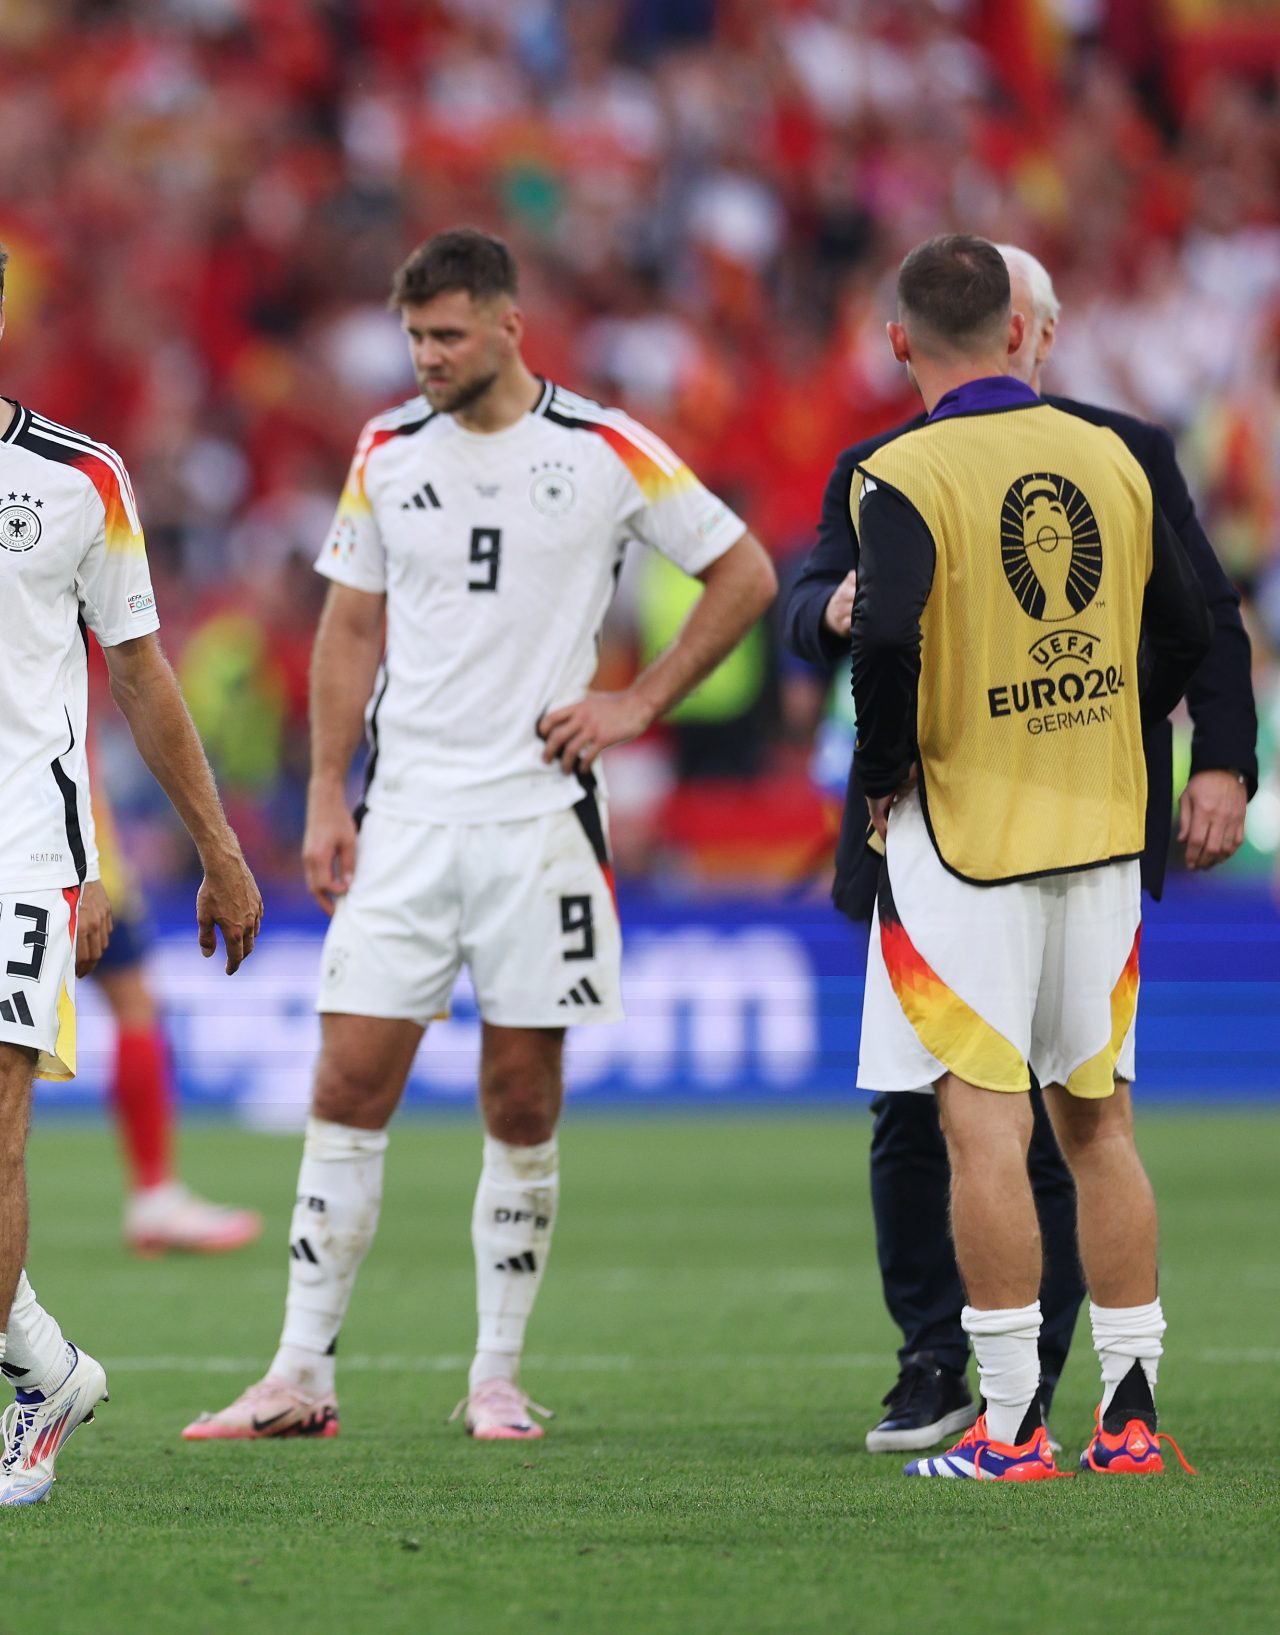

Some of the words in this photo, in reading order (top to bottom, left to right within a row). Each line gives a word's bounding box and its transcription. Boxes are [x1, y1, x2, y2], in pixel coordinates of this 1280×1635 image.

[469, 527, 501, 592] 9
[1032, 636, 1094, 665] UEFA
[560, 895, 594, 961] 9
